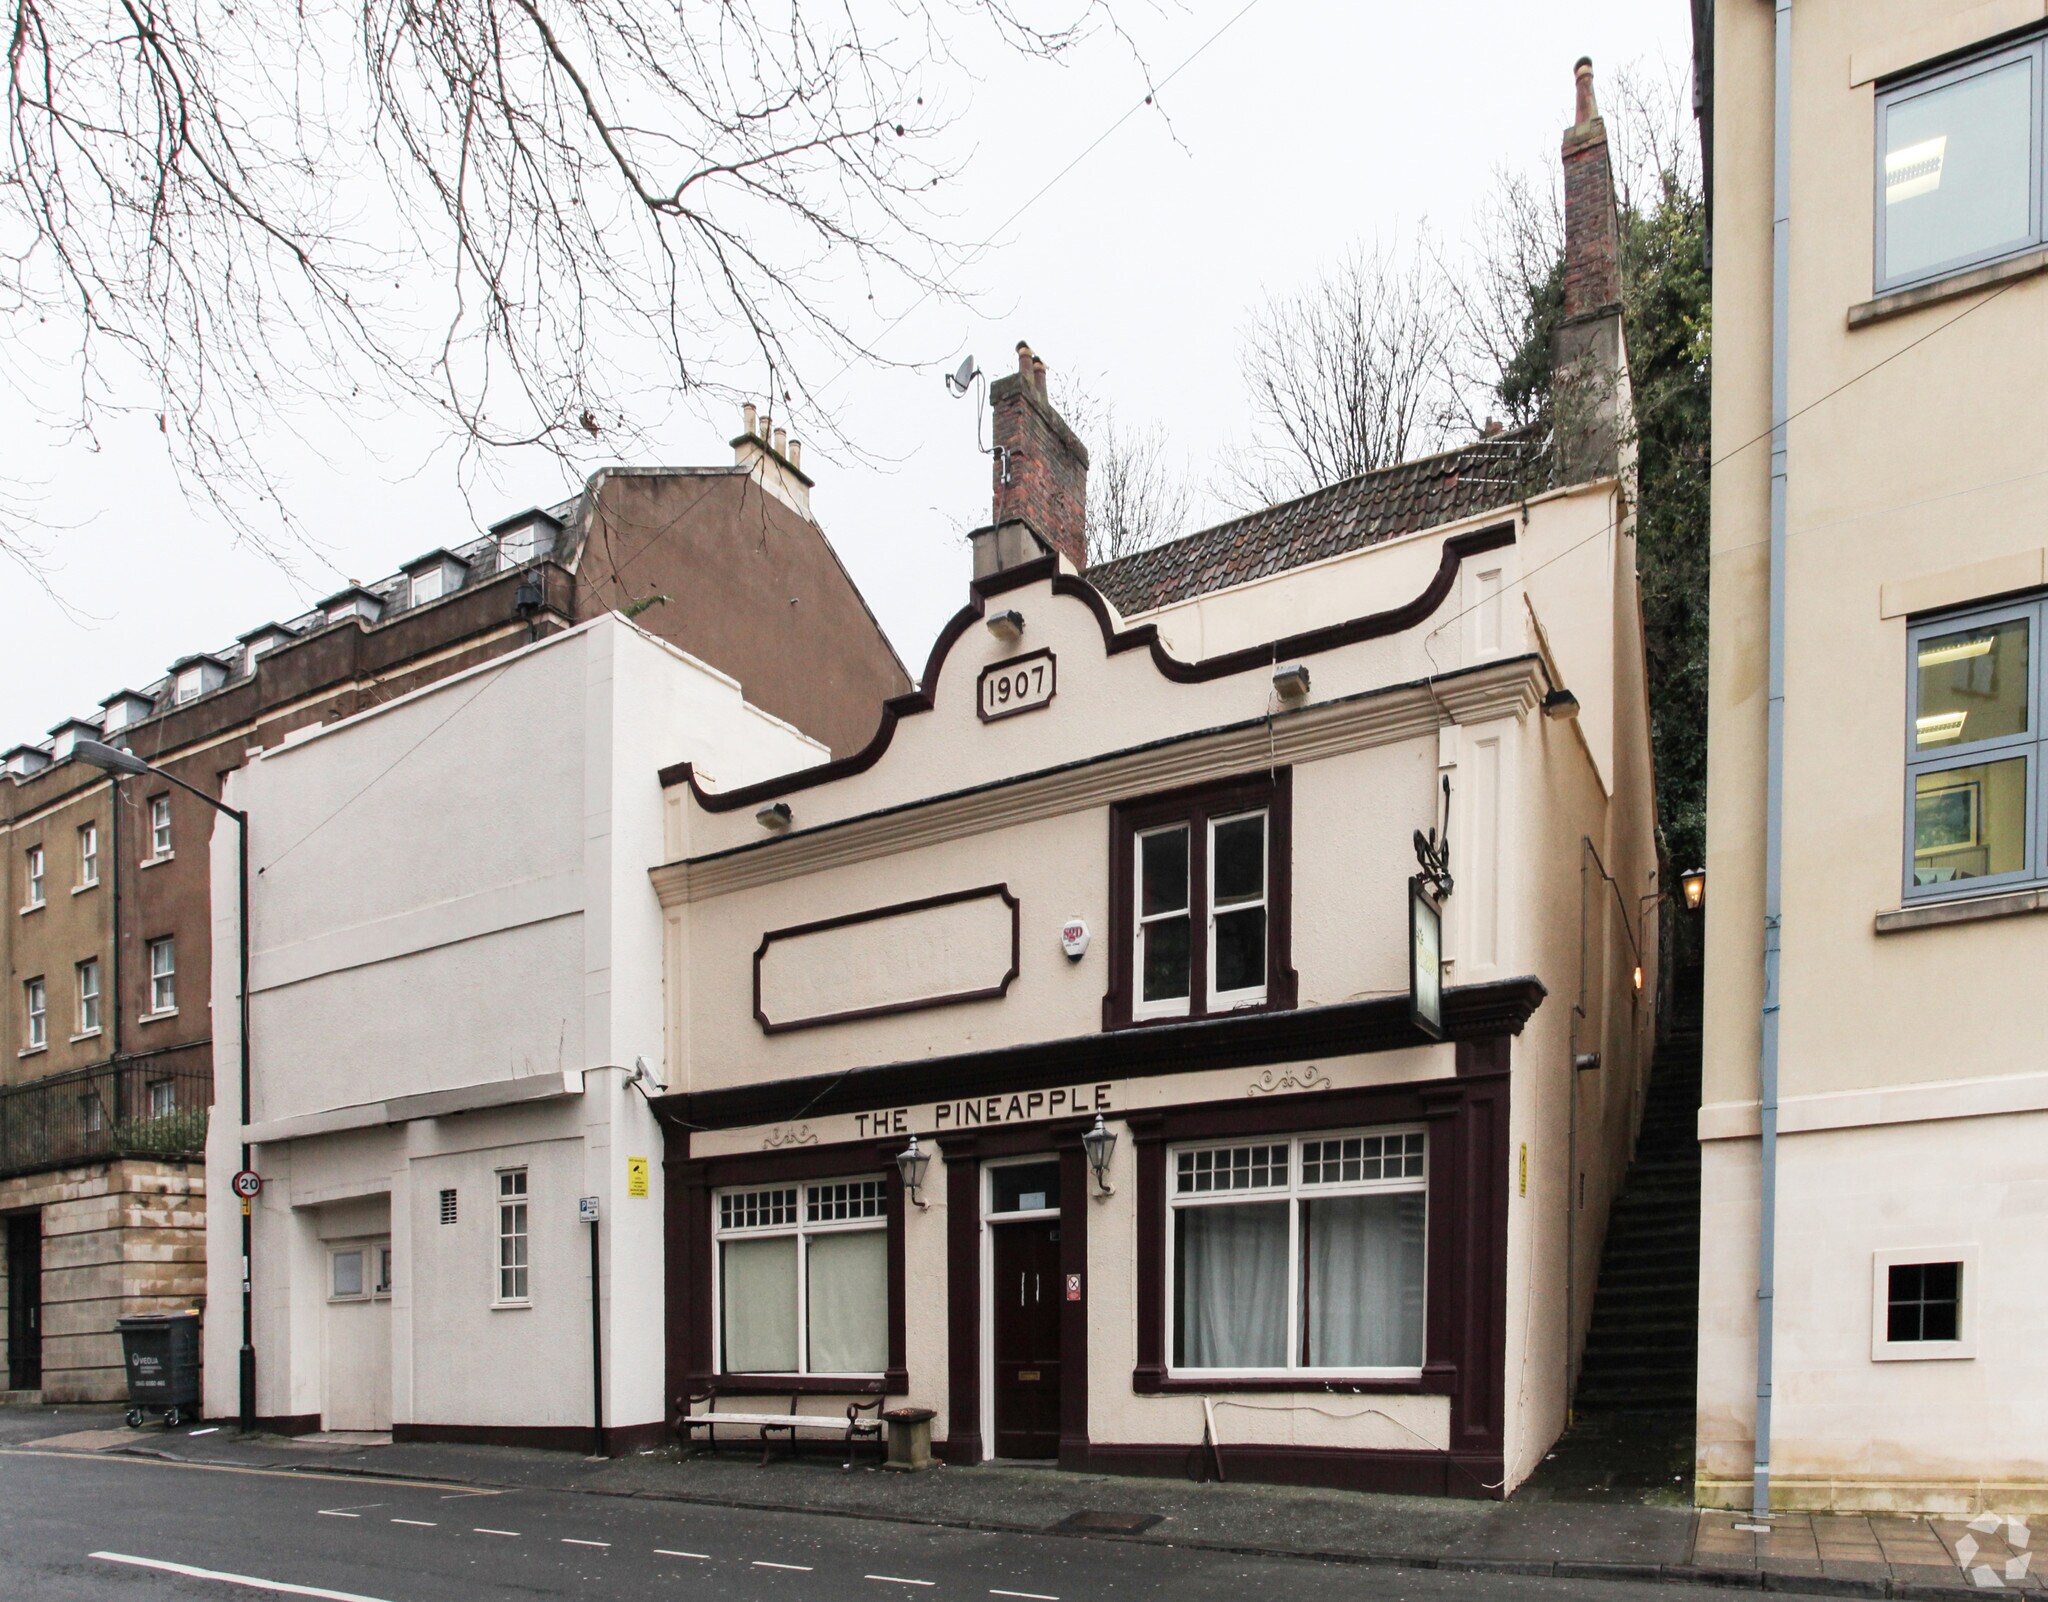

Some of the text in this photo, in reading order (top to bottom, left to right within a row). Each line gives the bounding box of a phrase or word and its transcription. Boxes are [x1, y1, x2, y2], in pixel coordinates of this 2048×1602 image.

[989, 665, 1044, 706] 1907
[855, 1084, 1112, 1137] THE PINEAPPLE
[240, 1178, 259, 1190] 20
